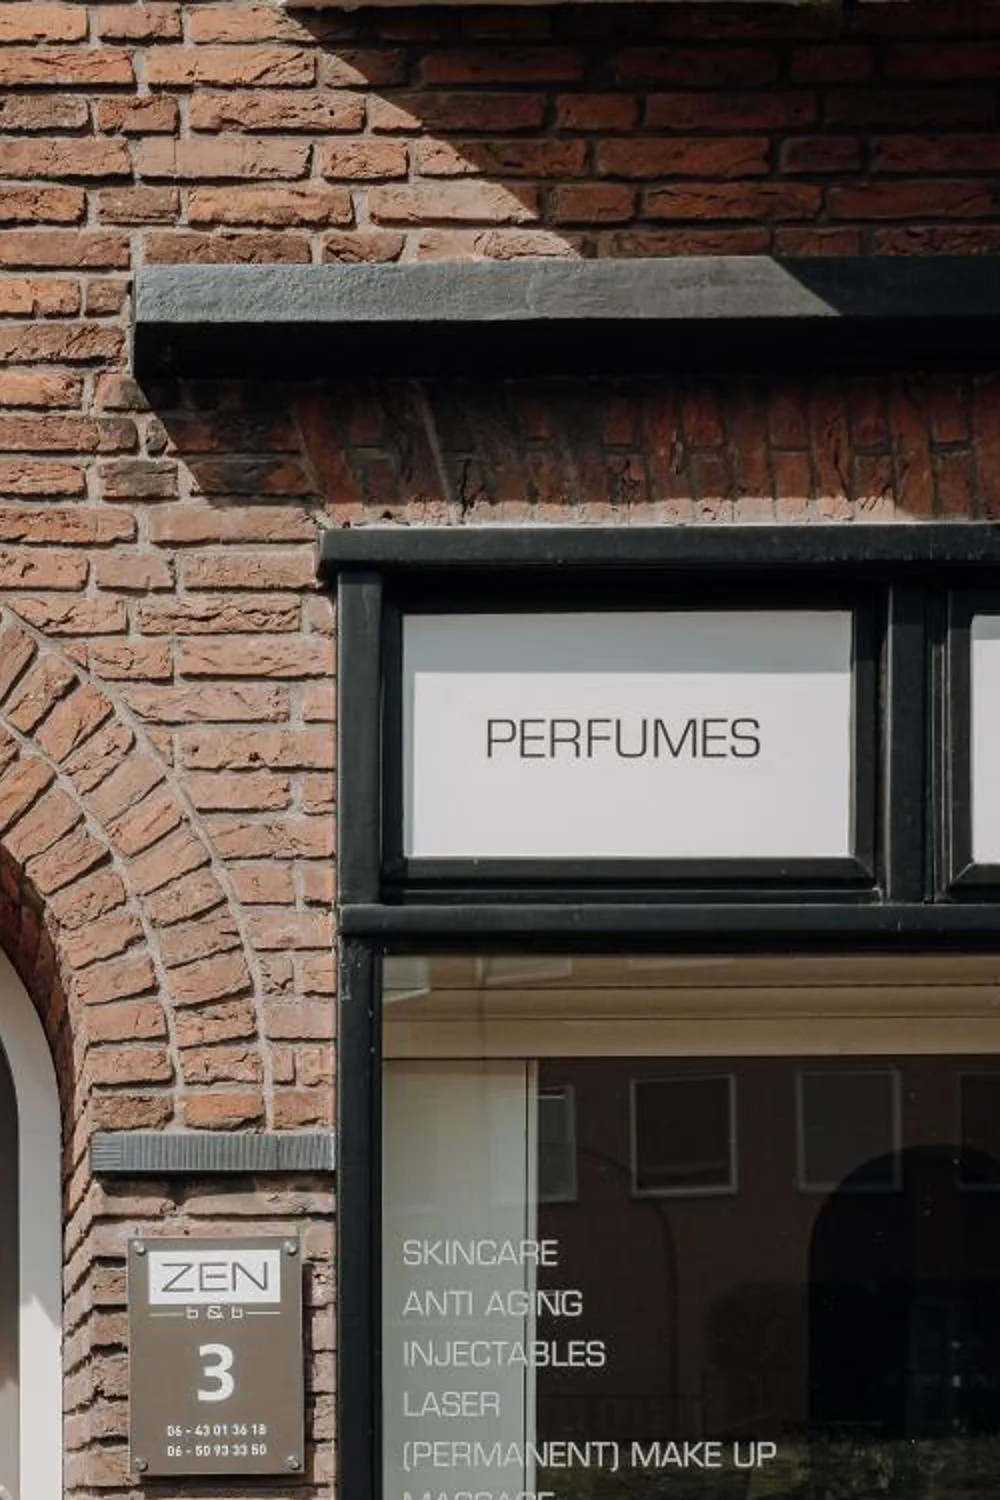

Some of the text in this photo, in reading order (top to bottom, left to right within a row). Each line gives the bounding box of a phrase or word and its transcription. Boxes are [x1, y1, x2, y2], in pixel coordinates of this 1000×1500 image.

[486, 717, 761, 759] PERFUMES
[402, 1240, 559, 1266] SKINCARE
[161, 1261, 268, 1292] ZEN
[402, 1290, 584, 1316] ANTI AGING
[402, 1341, 606, 1367] INJECTABLES
[197, 1343, 235, 1402] 3
[402, 1391, 500, 1417] LASER
[402, 1441, 778, 1470] (PERMANENT) MAKE UP
